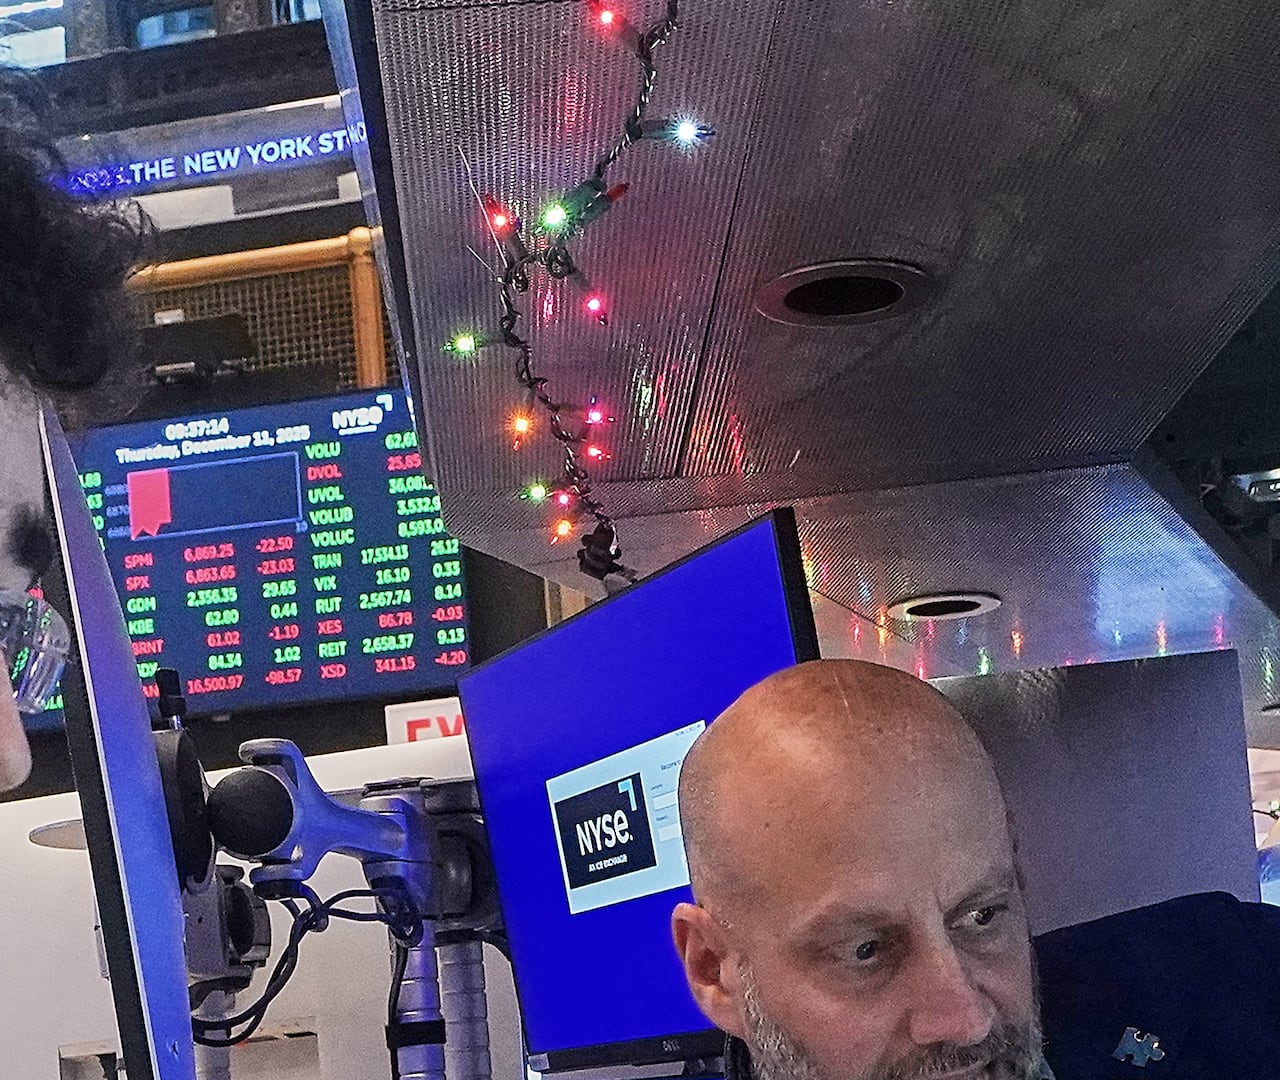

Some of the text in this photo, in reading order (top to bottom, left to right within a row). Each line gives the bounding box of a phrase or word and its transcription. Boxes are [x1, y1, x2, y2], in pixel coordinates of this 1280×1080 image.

[130, 157, 176, 185] THE
[183, 146, 240, 176] NEW
[246, 135, 314, 166] YORK
[116, 443, 180, 463] Thursday,
[182, 434, 251, 456] December
[276, 425, 311, 443] 2025
[305, 441, 341, 459] VOLU
[307, 464, 342, 481] DVOL
[307, 486, 345, 504] UVOL
[310, 528, 355, 548] VOLUC
[125, 575, 151, 591] SPX
[313, 575, 337, 591] VIX
[315, 596, 342, 614] RUT
[317, 619, 343, 635] XES
[318, 640, 347, 658] REIT
[320, 664, 347, 679] XSD
